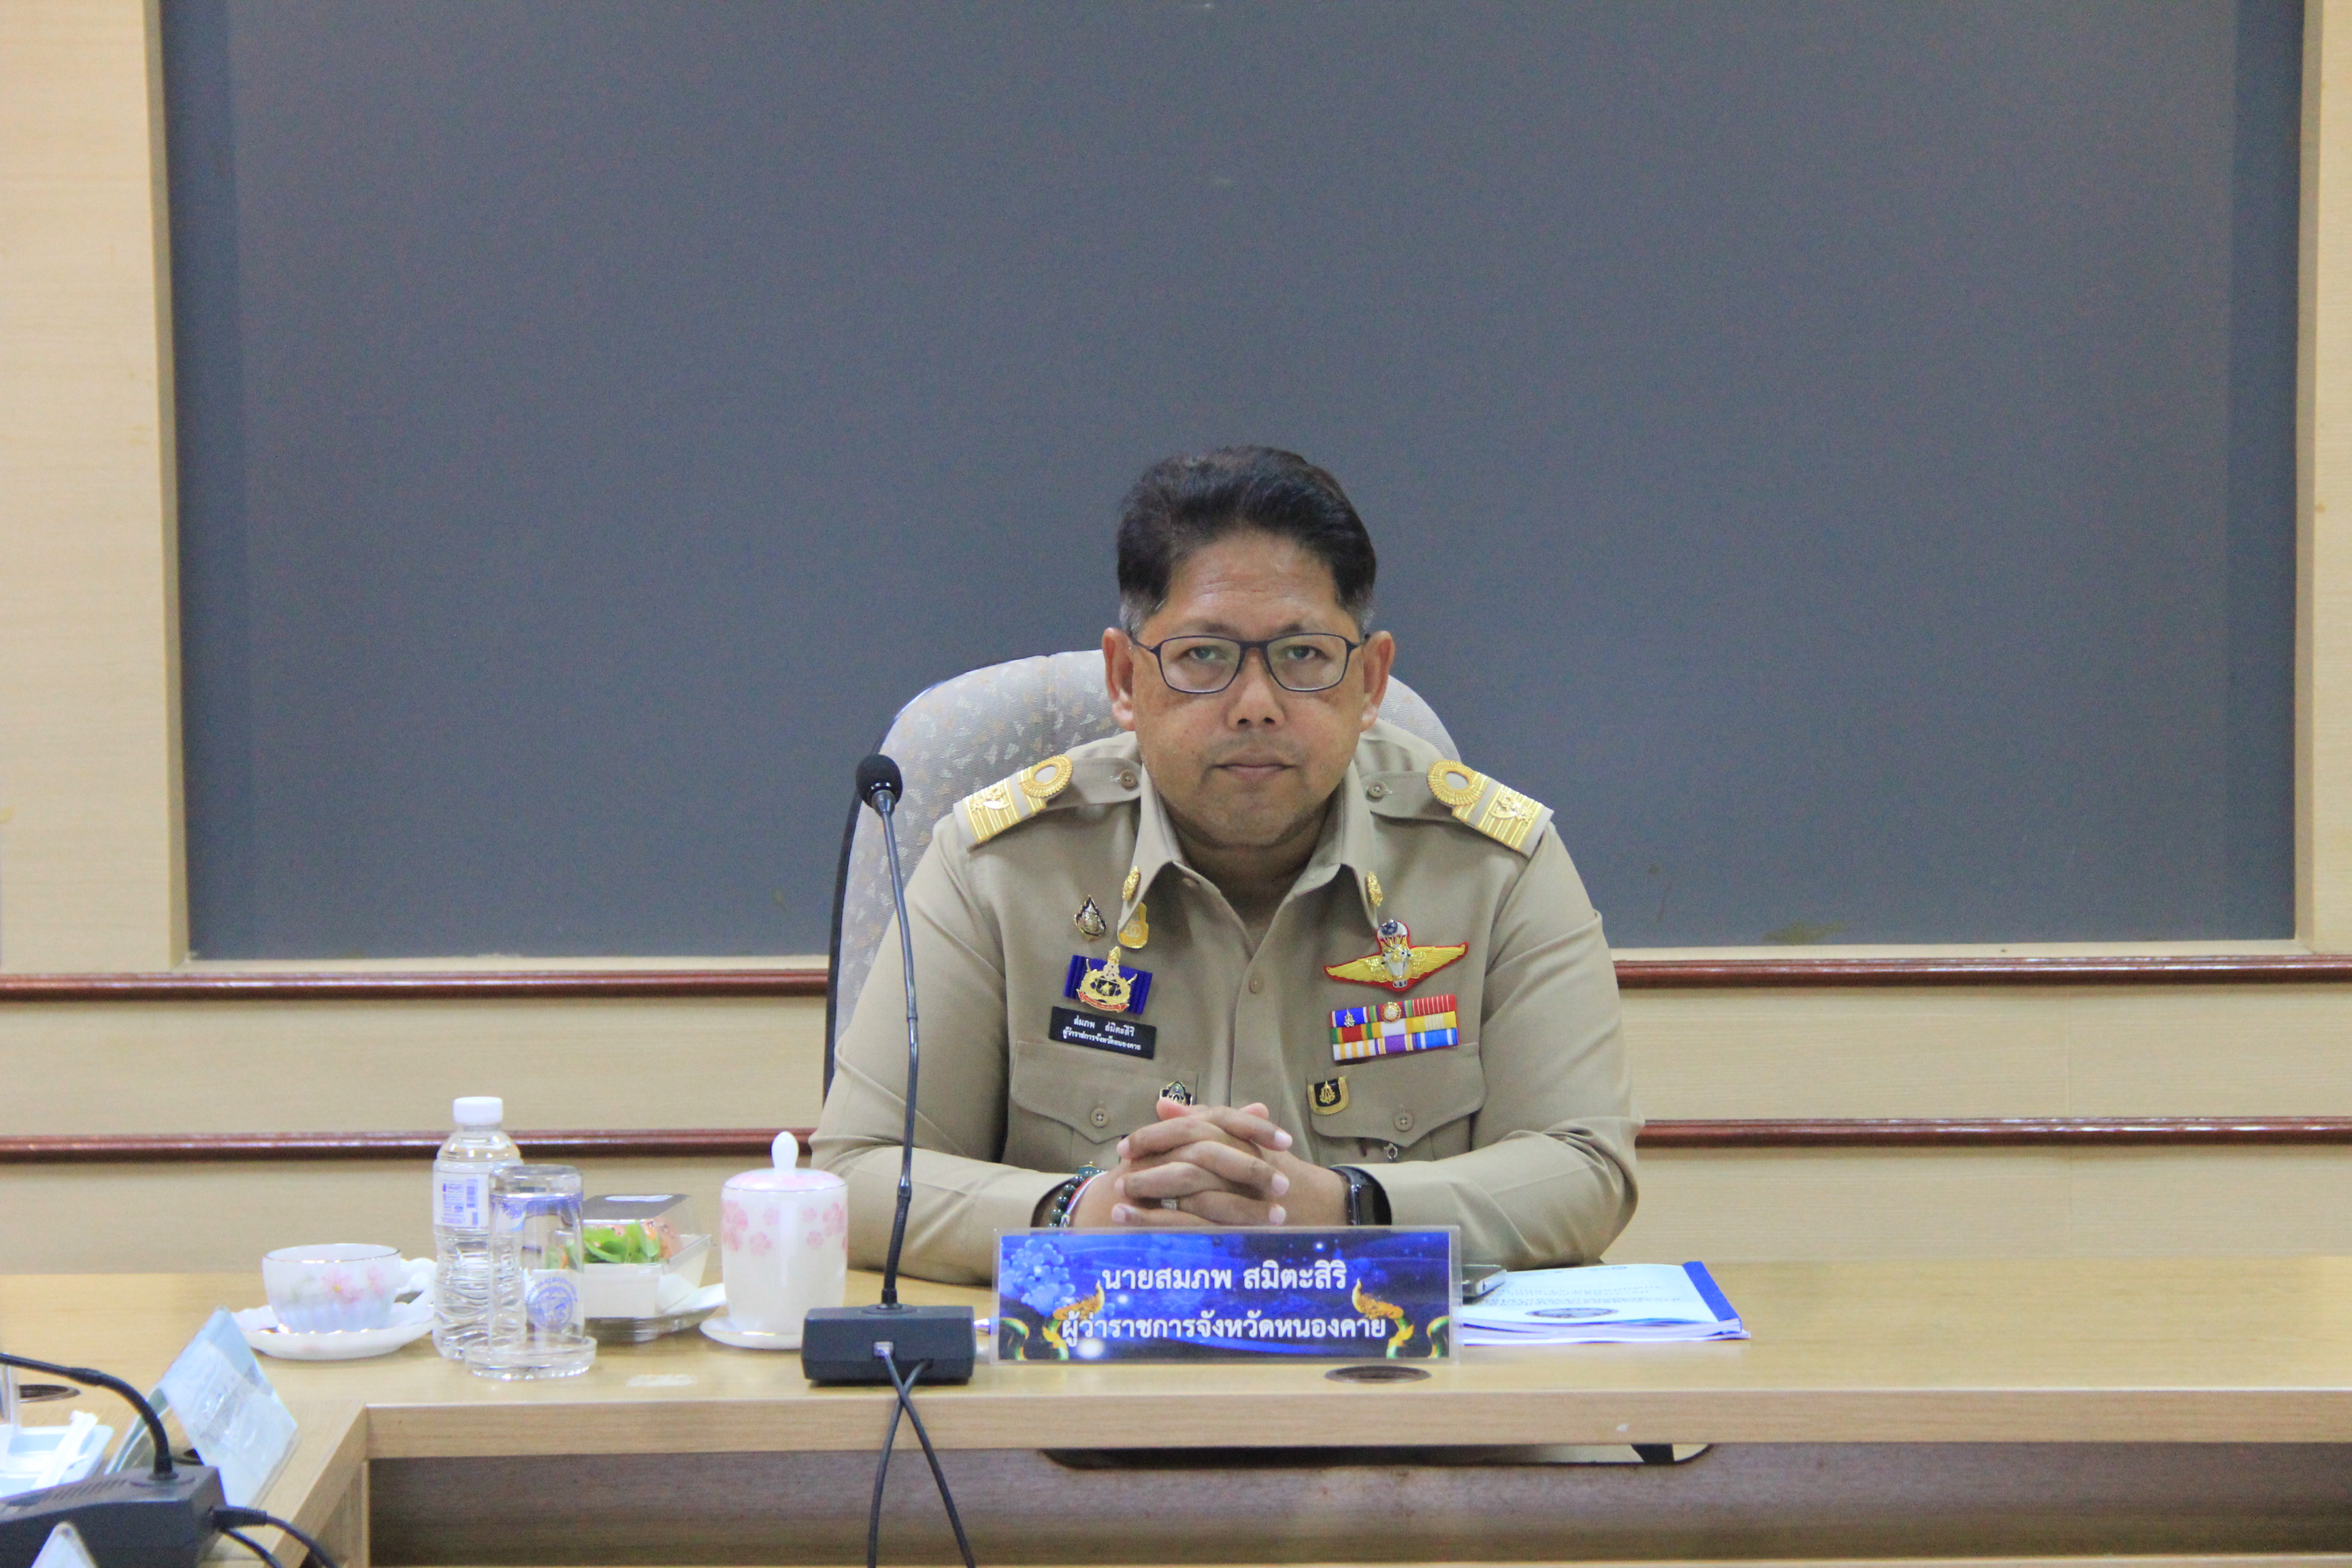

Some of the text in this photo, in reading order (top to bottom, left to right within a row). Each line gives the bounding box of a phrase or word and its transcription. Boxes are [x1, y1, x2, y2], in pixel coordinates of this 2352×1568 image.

[1102, 1259, 1348, 1290] นายสมภพ สมิตะสิริ
[1062, 1309, 1386, 1348] ผู้ว่าราชการจังหวัดหนองคาย
